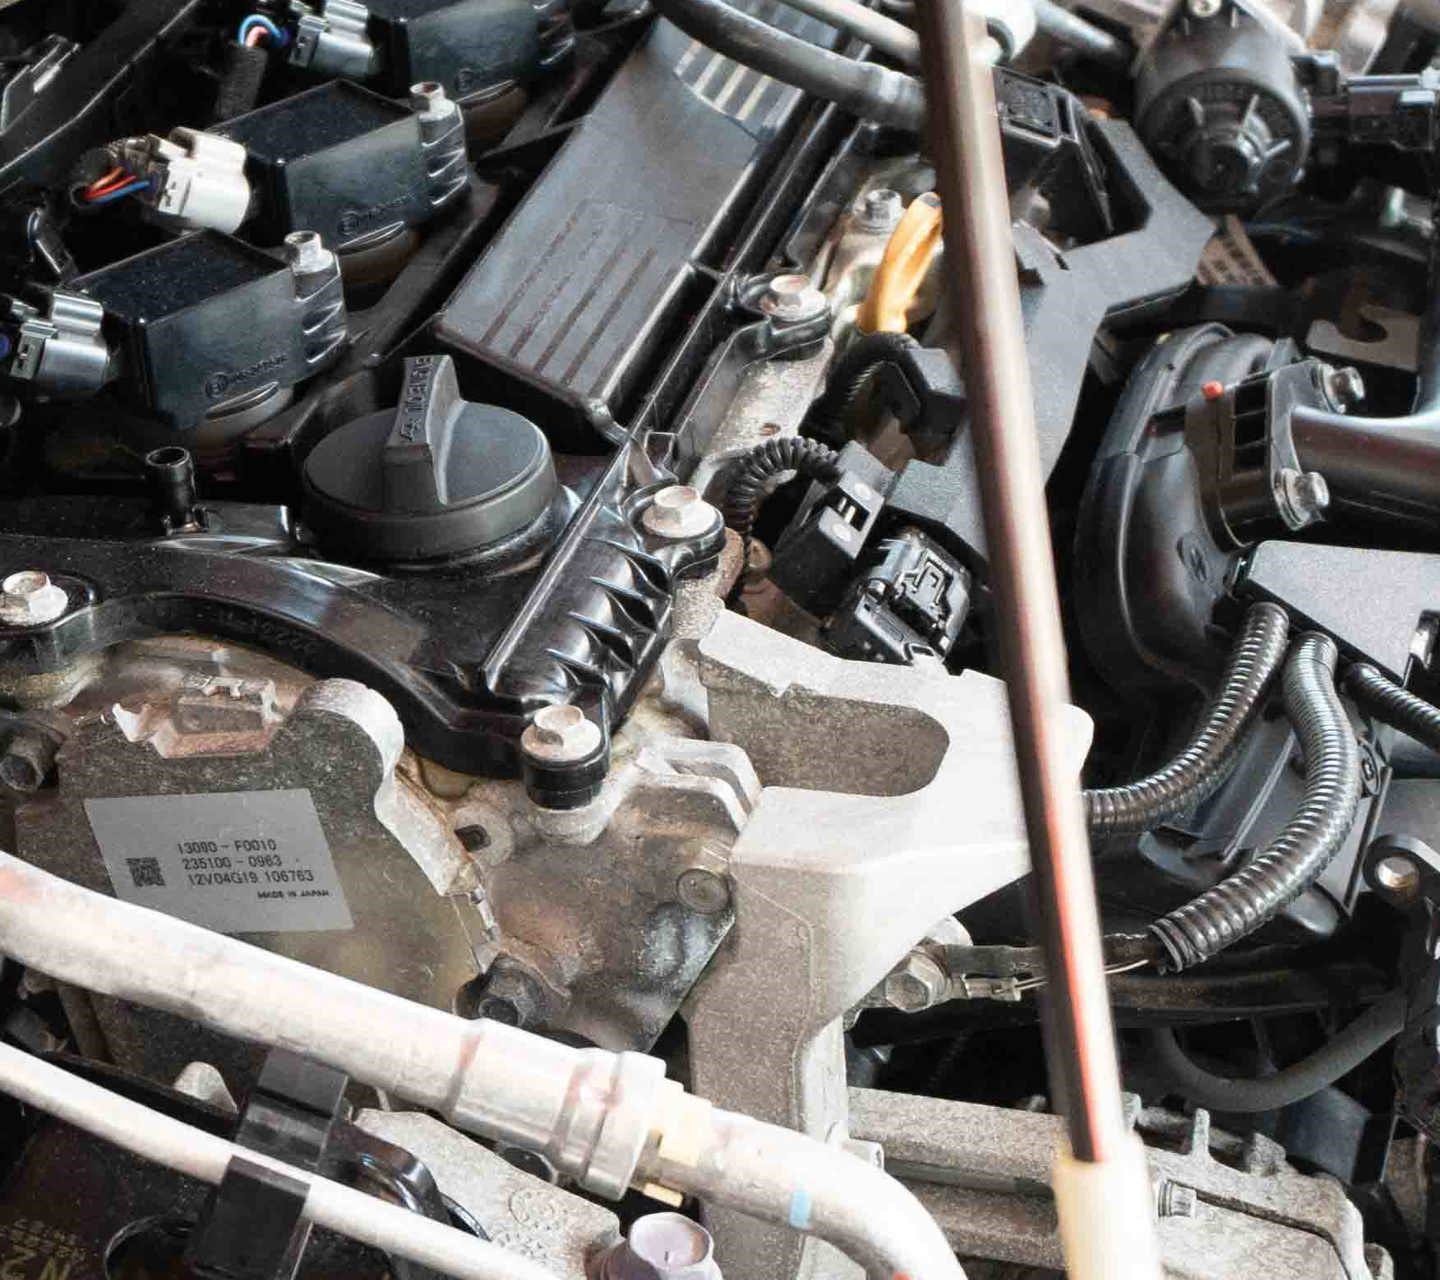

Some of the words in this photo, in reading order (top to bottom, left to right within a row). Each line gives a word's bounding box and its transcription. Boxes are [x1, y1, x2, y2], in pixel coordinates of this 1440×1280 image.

[182, 857, 232, 871] 235100
[257, 891, 285, 899] MADE
[300, 890, 330, 898] JAPAN
